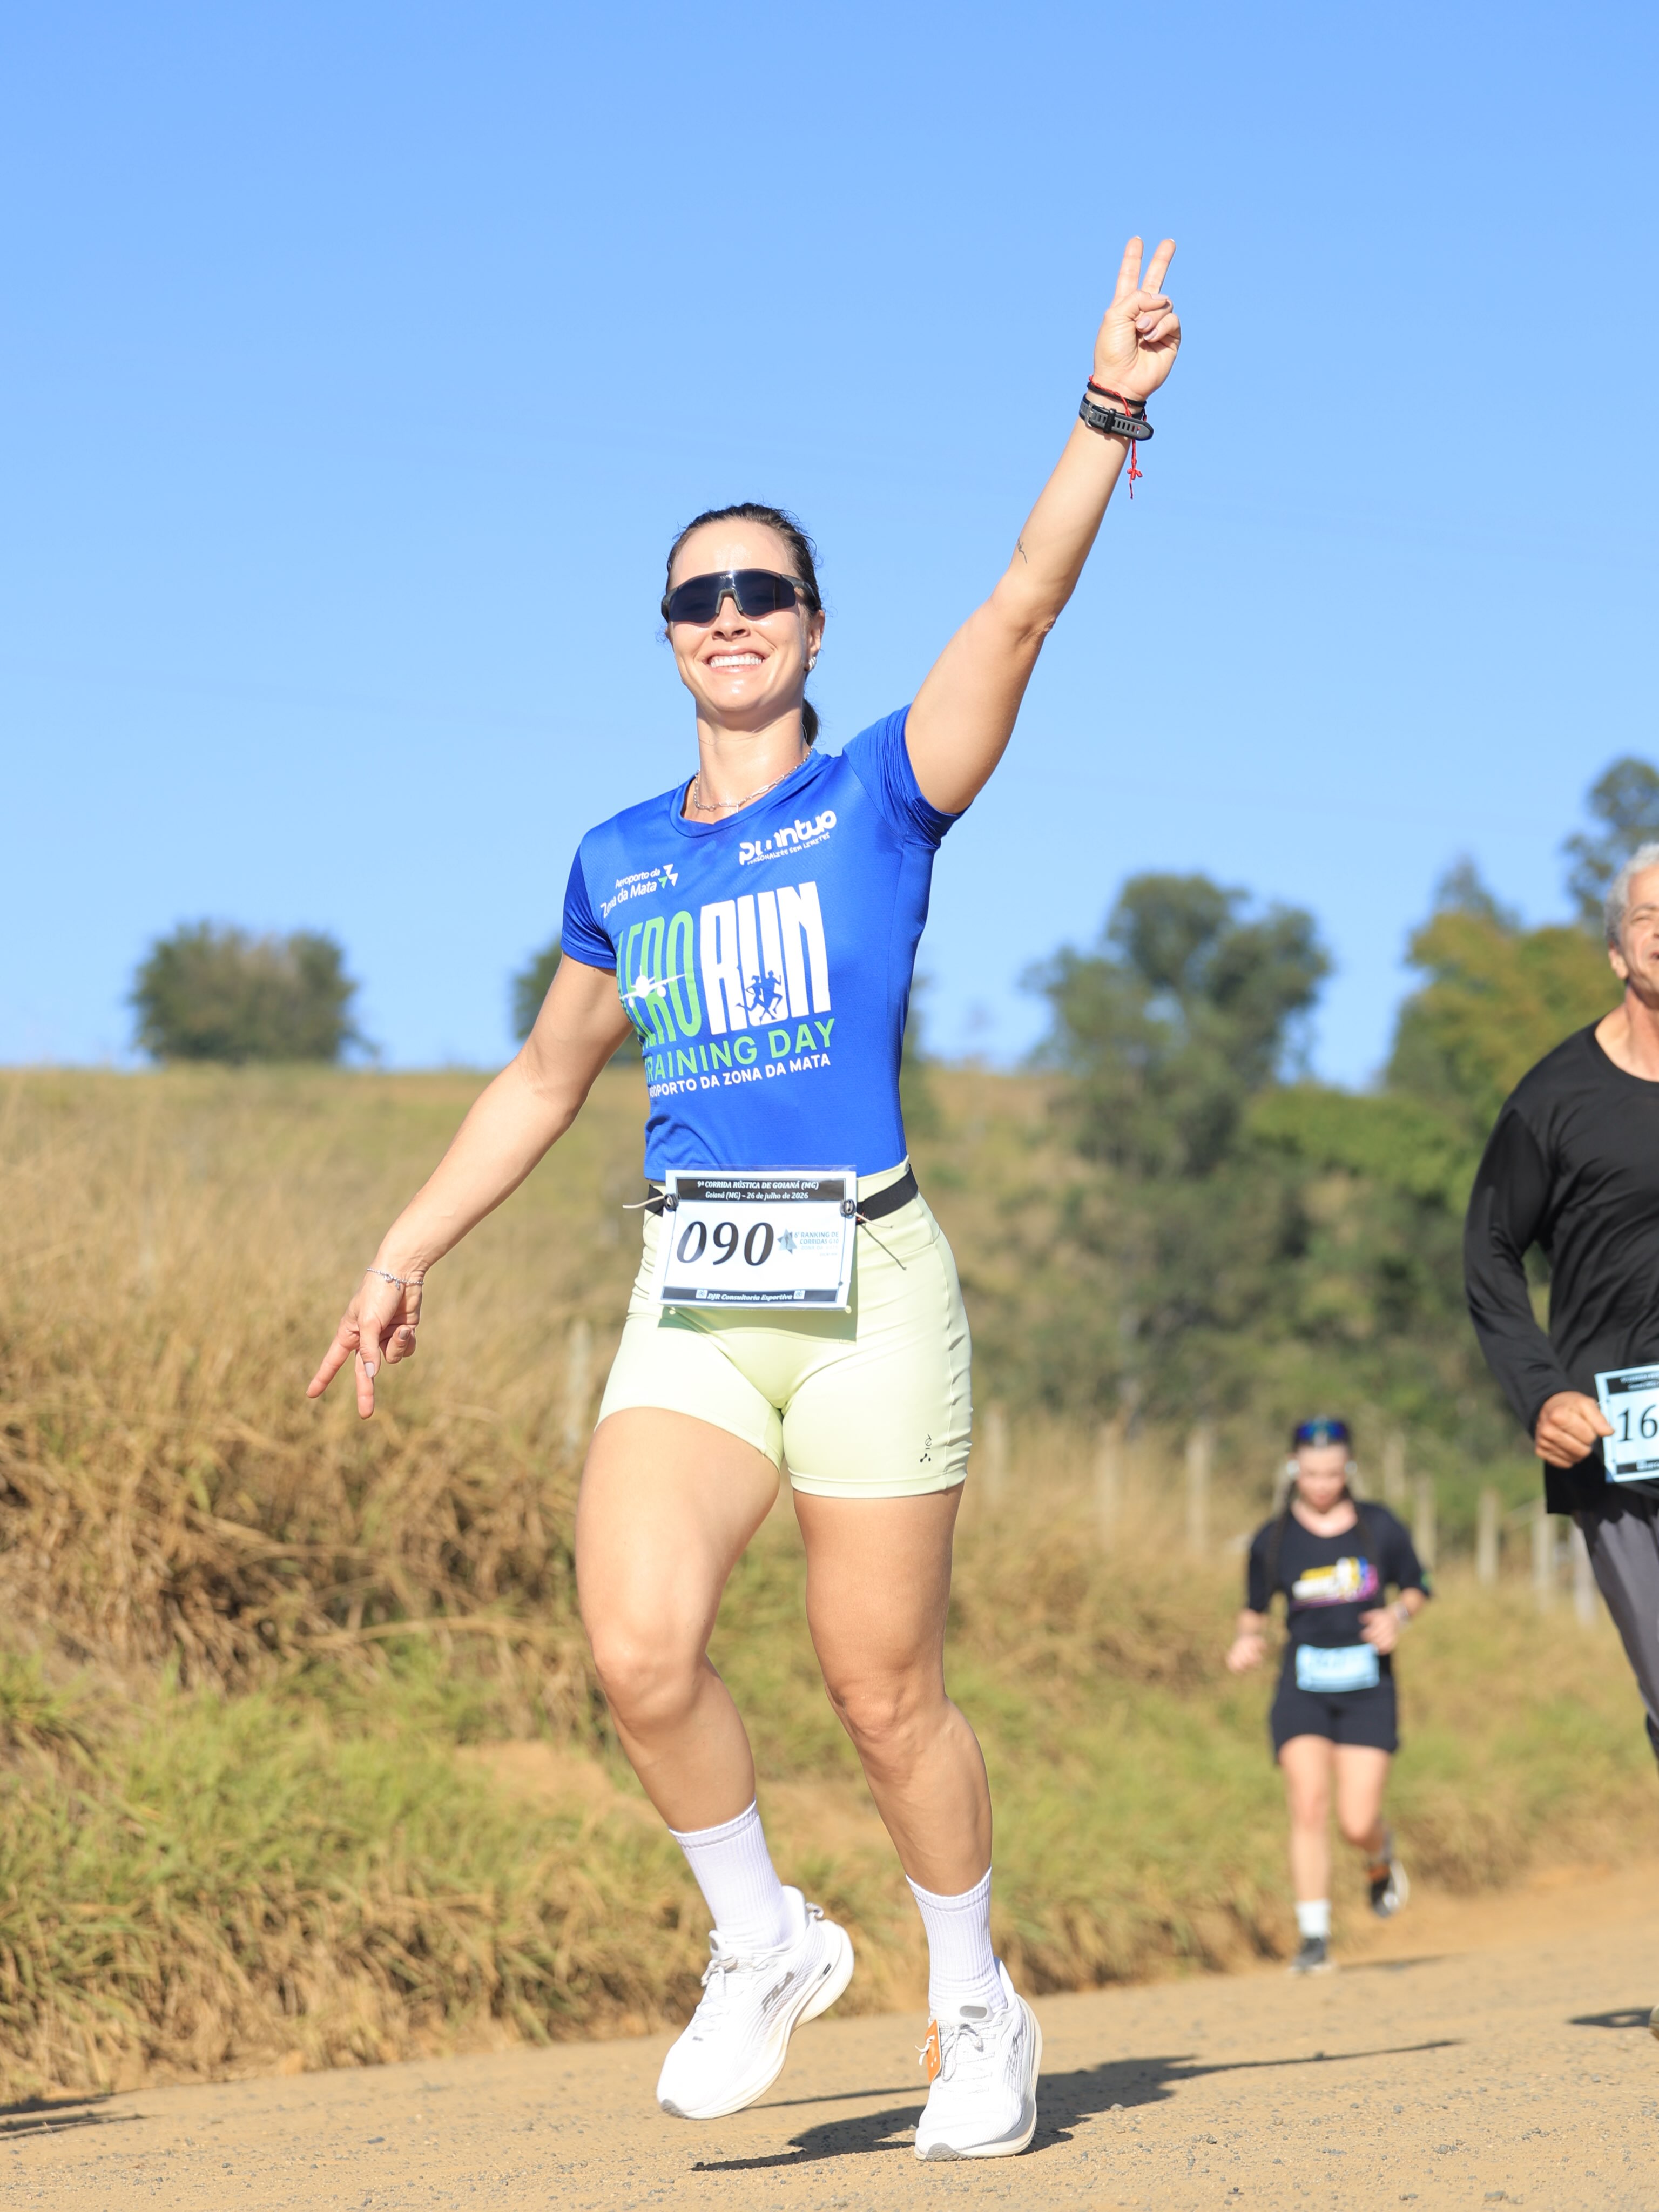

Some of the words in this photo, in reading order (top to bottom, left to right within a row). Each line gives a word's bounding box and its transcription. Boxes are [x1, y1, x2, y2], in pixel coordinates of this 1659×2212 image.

[615, 872, 650, 889] Aeroporto
[650, 868, 661, 878] da
[600, 896, 617, 918] Zona
[617, 888, 628, 903] da
[630, 881, 657, 899] Mata
[768, 1018, 835, 1058] DAY
[700, 1075, 720, 1089] DA
[722, 1067, 763, 1085] ZONA
[765, 1062, 786, 1078] DA
[789, 1053, 831, 1073] MATA
[726, 1192, 741, 1200] (MG)
[764, 1192, 781, 1201] julho
[733, 1180, 760, 1189] RÚSTICA
[772, 1181, 800, 1189] GOIANÁ
[801, 1182, 819, 1190] (MG)
[677, 1220, 774, 1266] 090
